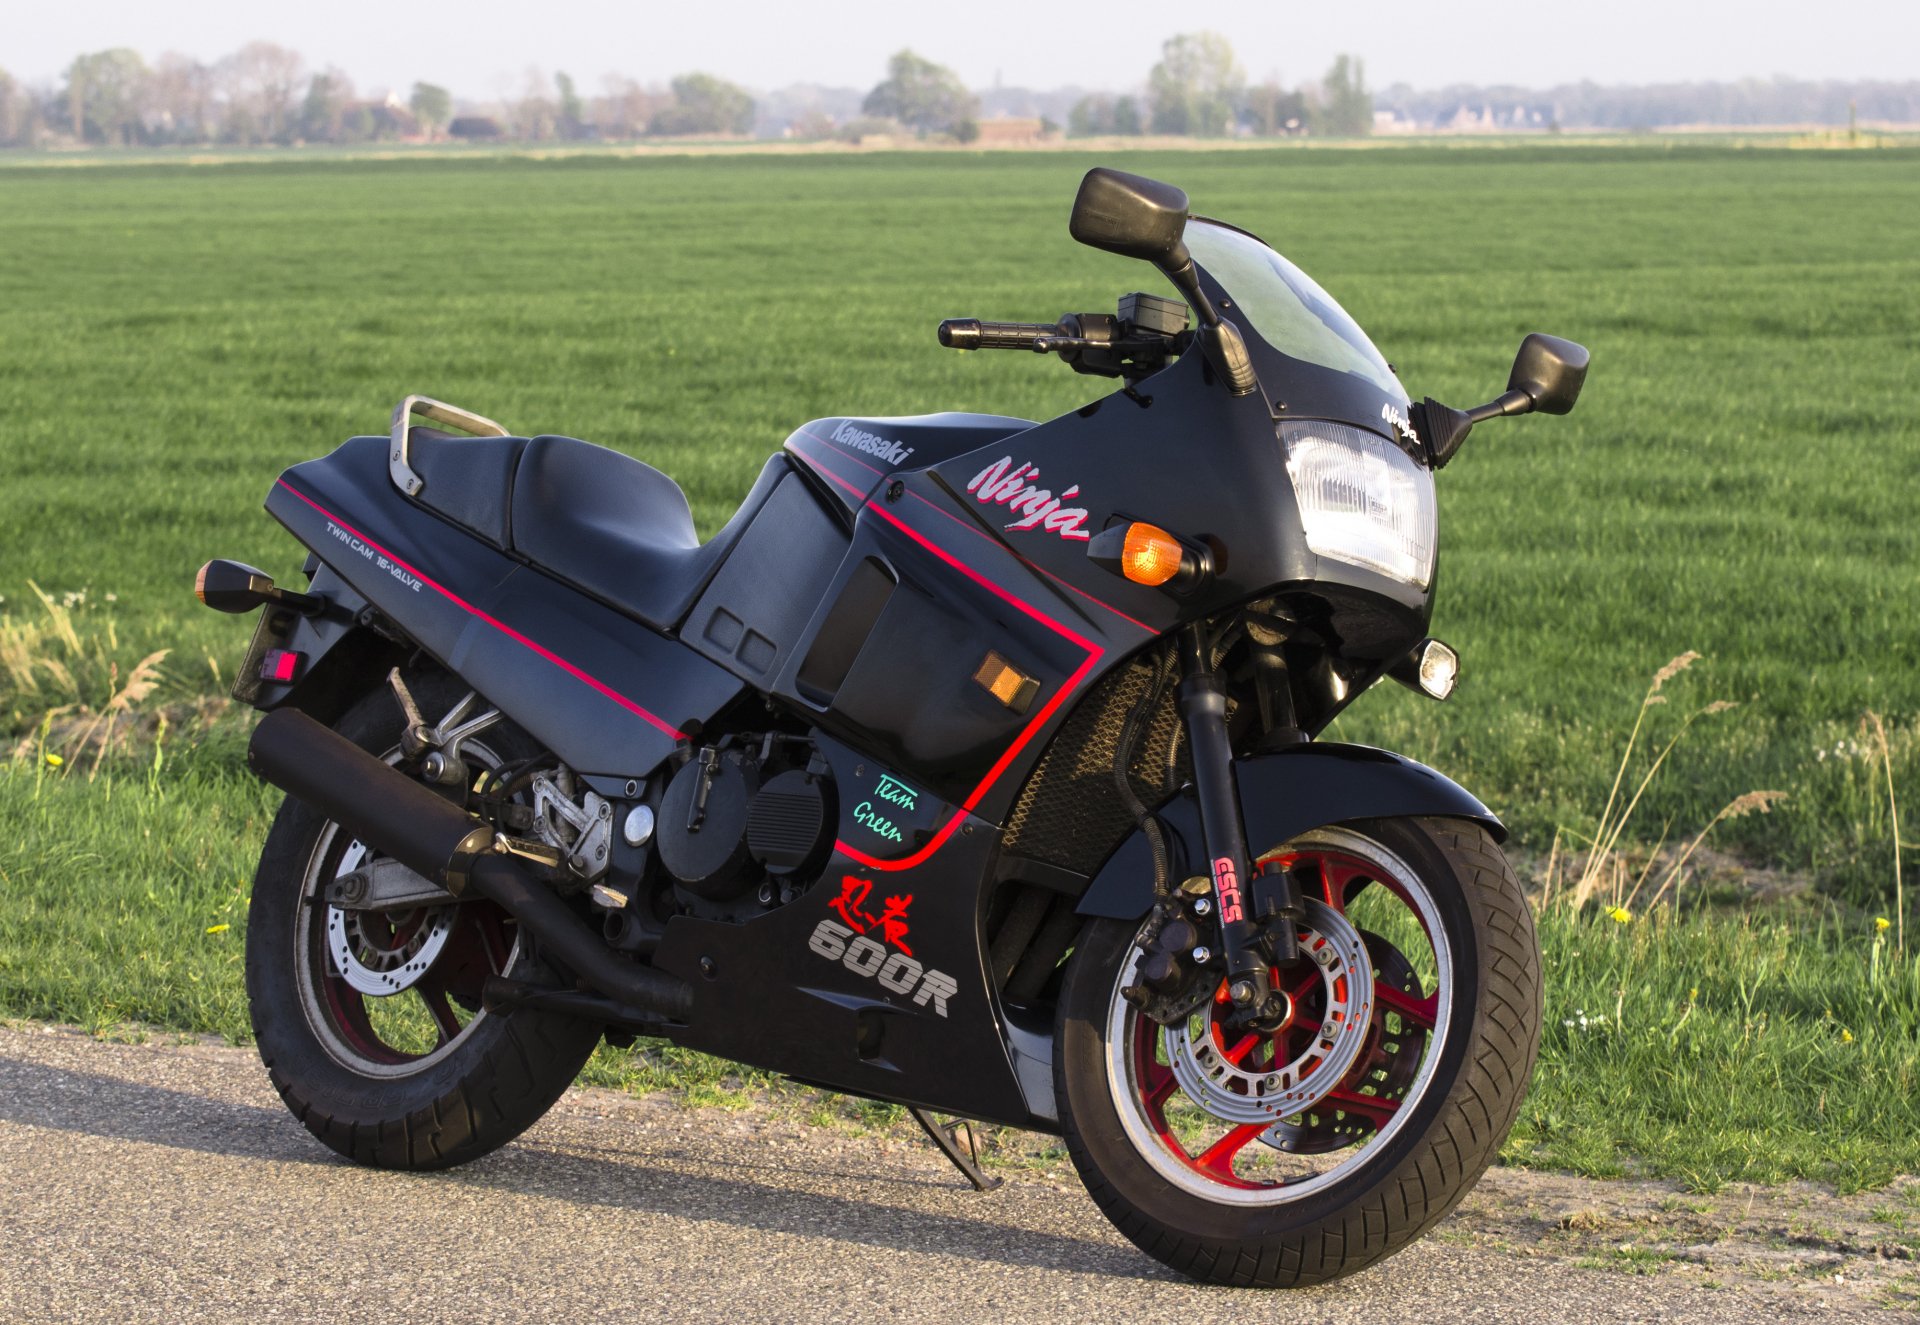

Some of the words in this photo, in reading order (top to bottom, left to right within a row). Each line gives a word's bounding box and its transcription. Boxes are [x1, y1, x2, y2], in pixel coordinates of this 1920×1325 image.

[830, 419, 915, 466] Kawasaki
[1382, 403, 1421, 445] Ninja
[967, 455, 1090, 541] Ninja
[327, 521, 352, 545] TWIN
[350, 539, 374, 560] CAM
[873, 773, 918, 810] Team
[853, 801, 902, 842] Green
[808, 919, 958, 1018] 600R
